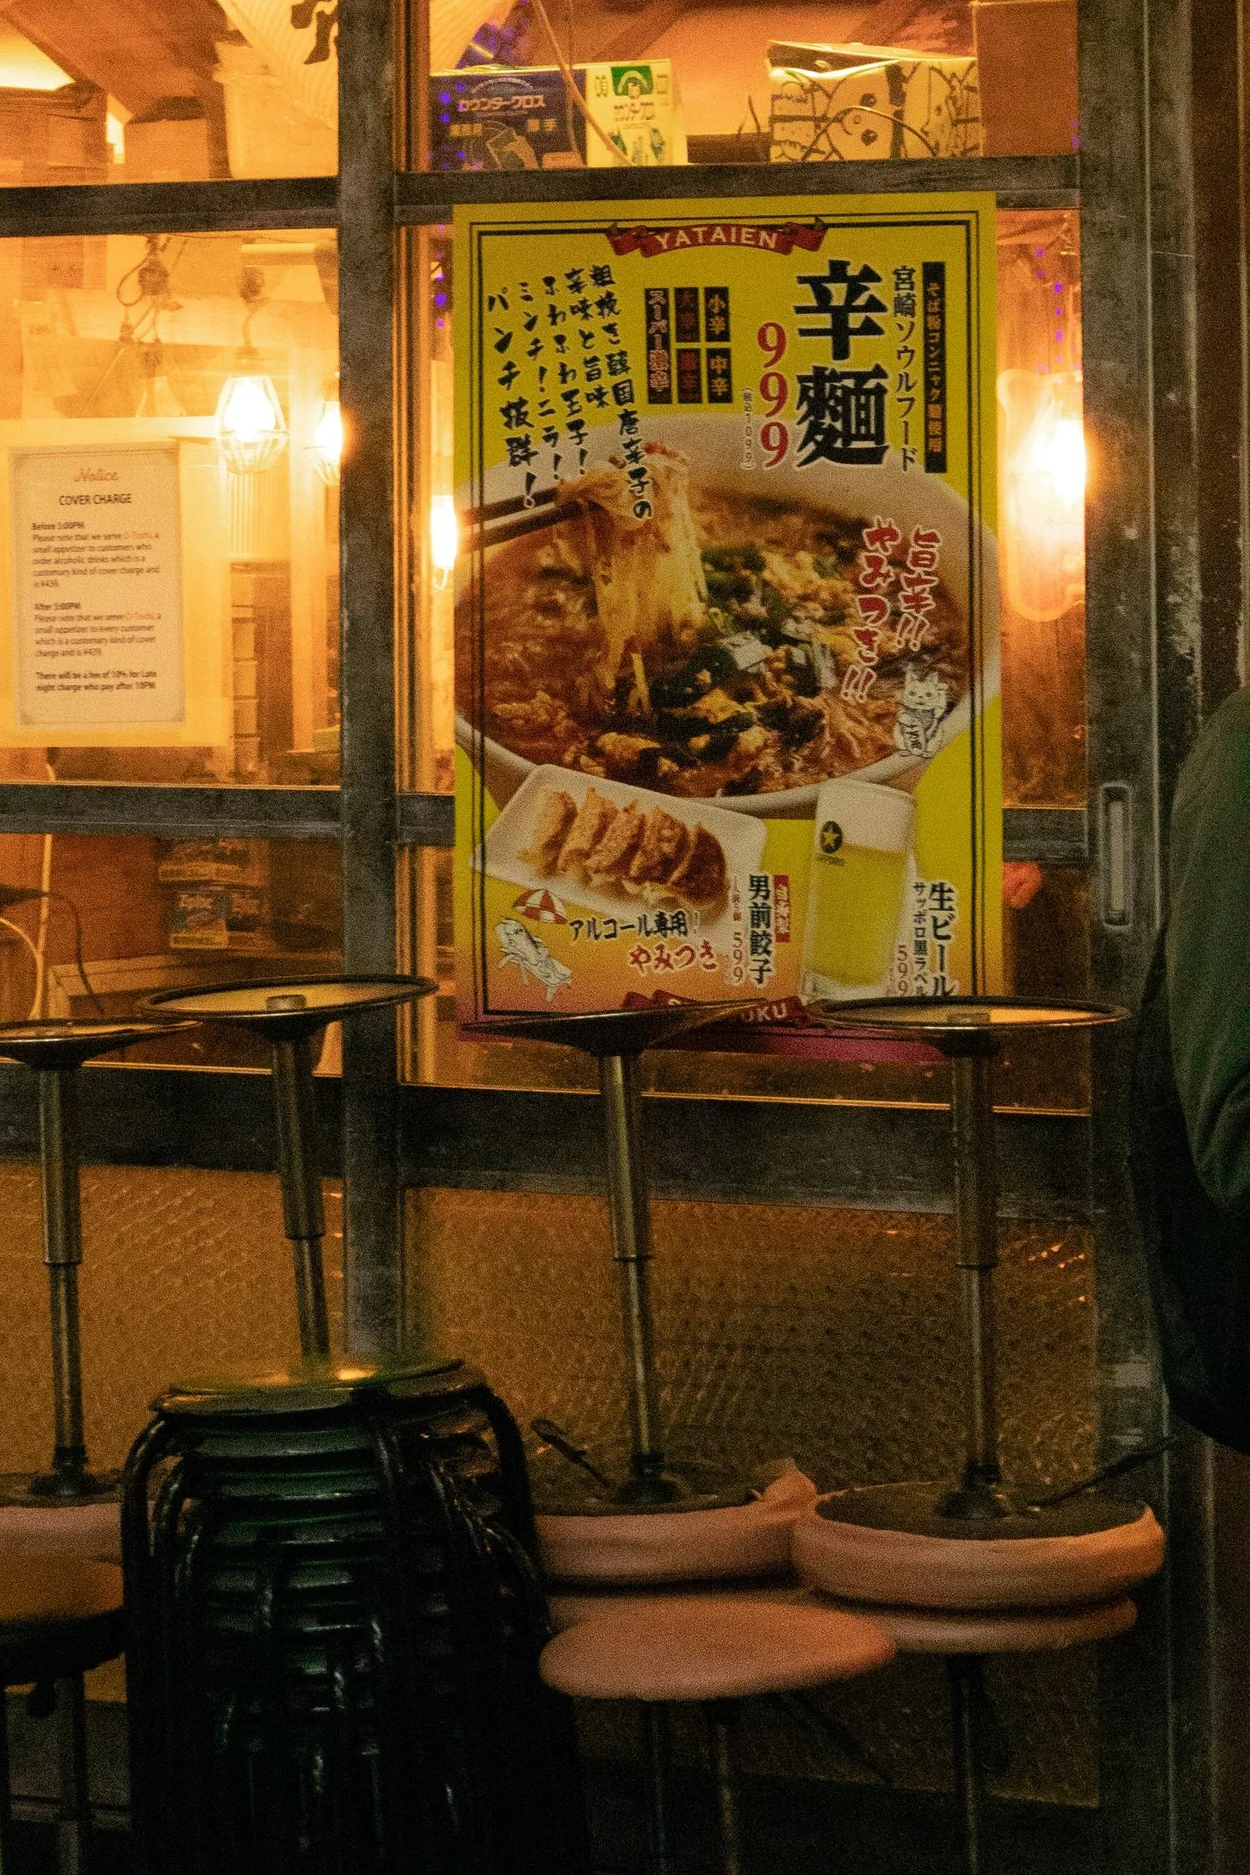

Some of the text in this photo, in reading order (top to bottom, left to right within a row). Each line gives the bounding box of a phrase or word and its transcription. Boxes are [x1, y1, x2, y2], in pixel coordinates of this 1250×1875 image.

[654, 225, 780, 252] YATAIEN
[565, 268, 609, 408] 辛味と旨味
[892, 265, 918, 471] 宮崎ソウルフード
[757, 322, 789, 469] 999
[58, 493, 132, 506] COVER CHARGE
[629, 939, 718, 974] やみつき
[733, 931, 744, 983] 599
[749, 875, 772, 984] 男前餃子
[929, 882, 958, 996] 生ビール
